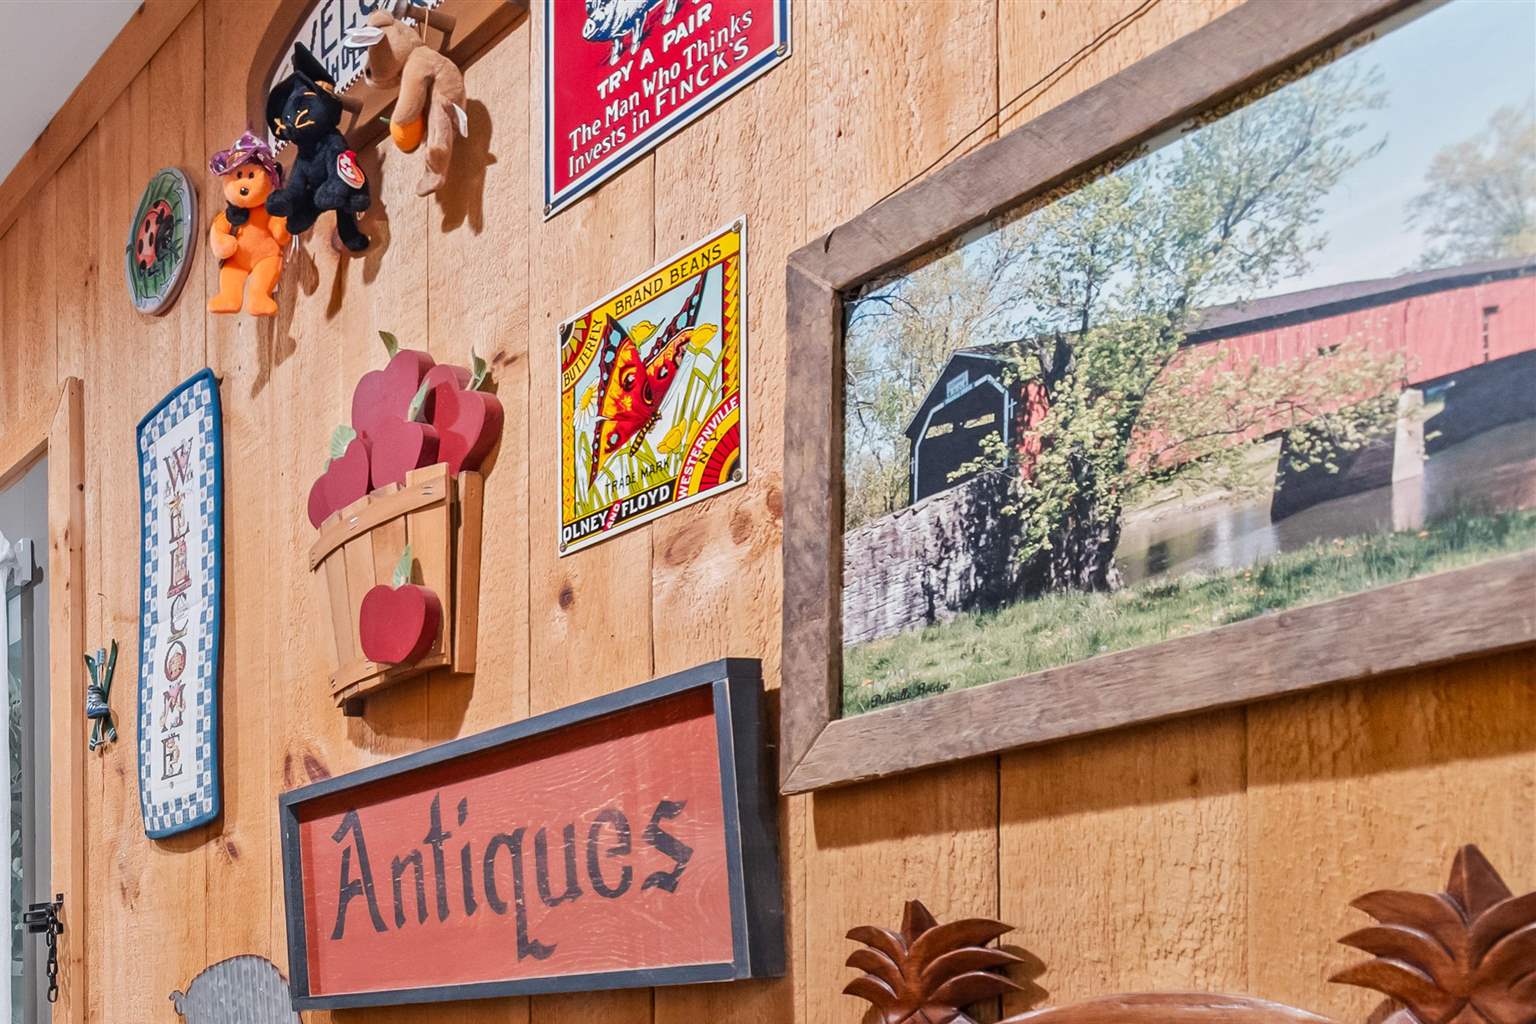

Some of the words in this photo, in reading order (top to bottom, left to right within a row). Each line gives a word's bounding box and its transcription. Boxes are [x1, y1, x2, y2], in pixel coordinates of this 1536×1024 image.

[568, 126, 626, 177] Invests
[632, 109, 649, 133] in
[655, 37, 750, 116] FINCK'S
[569, 119, 601, 151] The
[605, 92, 640, 128] Man
[642, 62, 681, 98] Who
[683, 10, 753, 70] Thinks
[597, 60, 633, 99] TRY
[640, 48, 654, 70] A
[663, 3, 713, 52] PAIR
[563, 319, 603, 388] BUTTERFLY
[615, 278, 663, 316] BRAND
[670, 244, 722, 285] BEANS
[563, 510, 609, 542] OLNEY
[607, 503, 620, 529] AND
[621, 485, 671, 518] FLOYD
[605, 473, 636, 492] TRADE
[640, 460, 670, 481] MARK
[678, 396, 739, 500] WESTERNVILLE
[162, 437, 194, 782] WELCOME
[330, 792, 695, 962] Antiques
